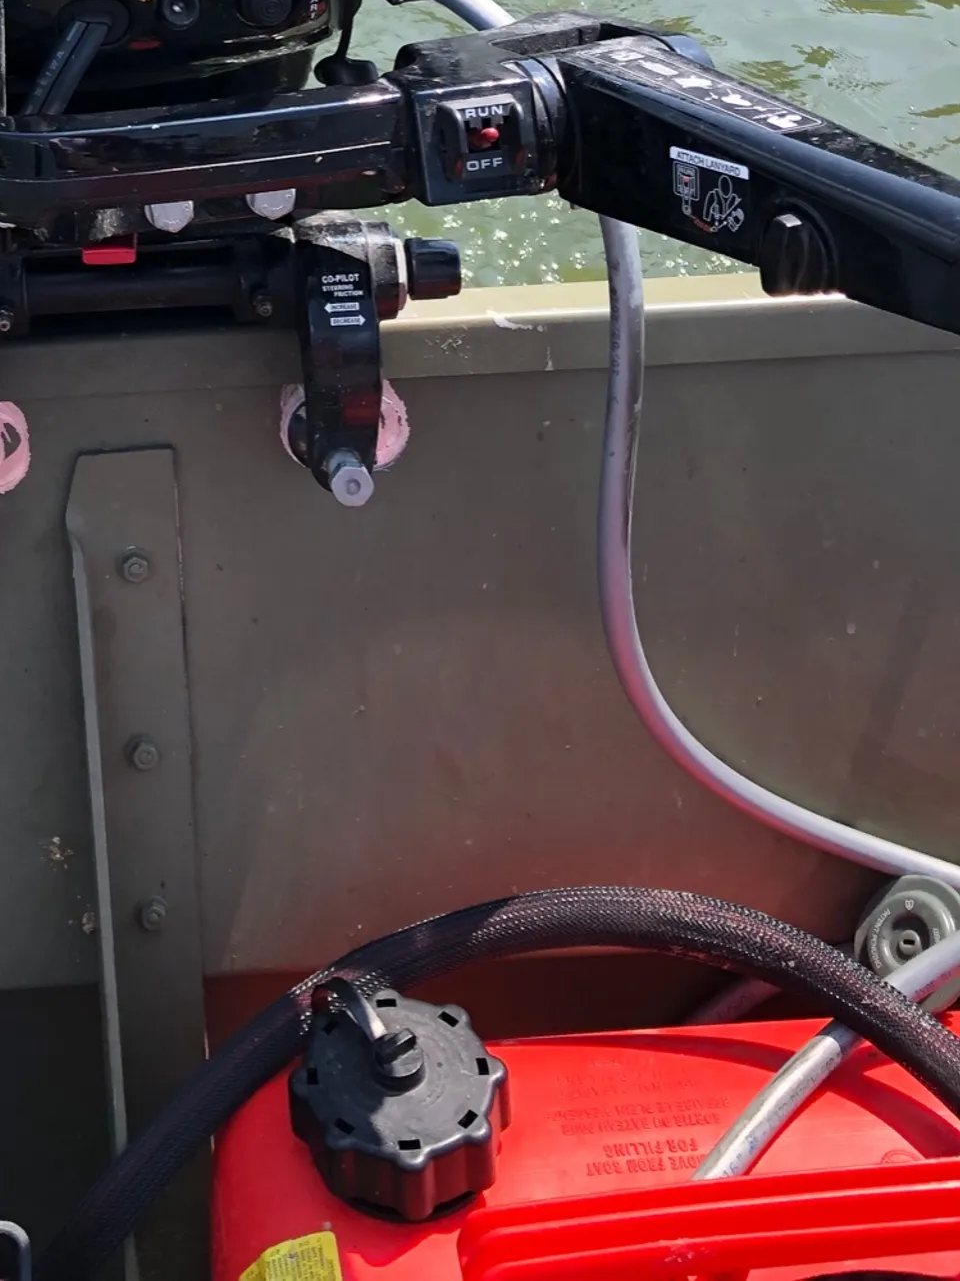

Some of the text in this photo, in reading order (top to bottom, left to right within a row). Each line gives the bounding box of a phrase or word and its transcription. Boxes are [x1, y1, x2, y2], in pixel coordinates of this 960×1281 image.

[465, 105, 503, 119] RUN
[466, 157, 503, 171] OFF
[676, 151, 704, 165] ATTACH
[705, 158, 741, 176] LANYARD
[321, 273, 360, 283] CO-PILOT
[602, 1137, 699, 1158] FOR FILLING
[586, 1159, 624, 1177] BOAT
[626, 1156, 666, 1174] FROM
